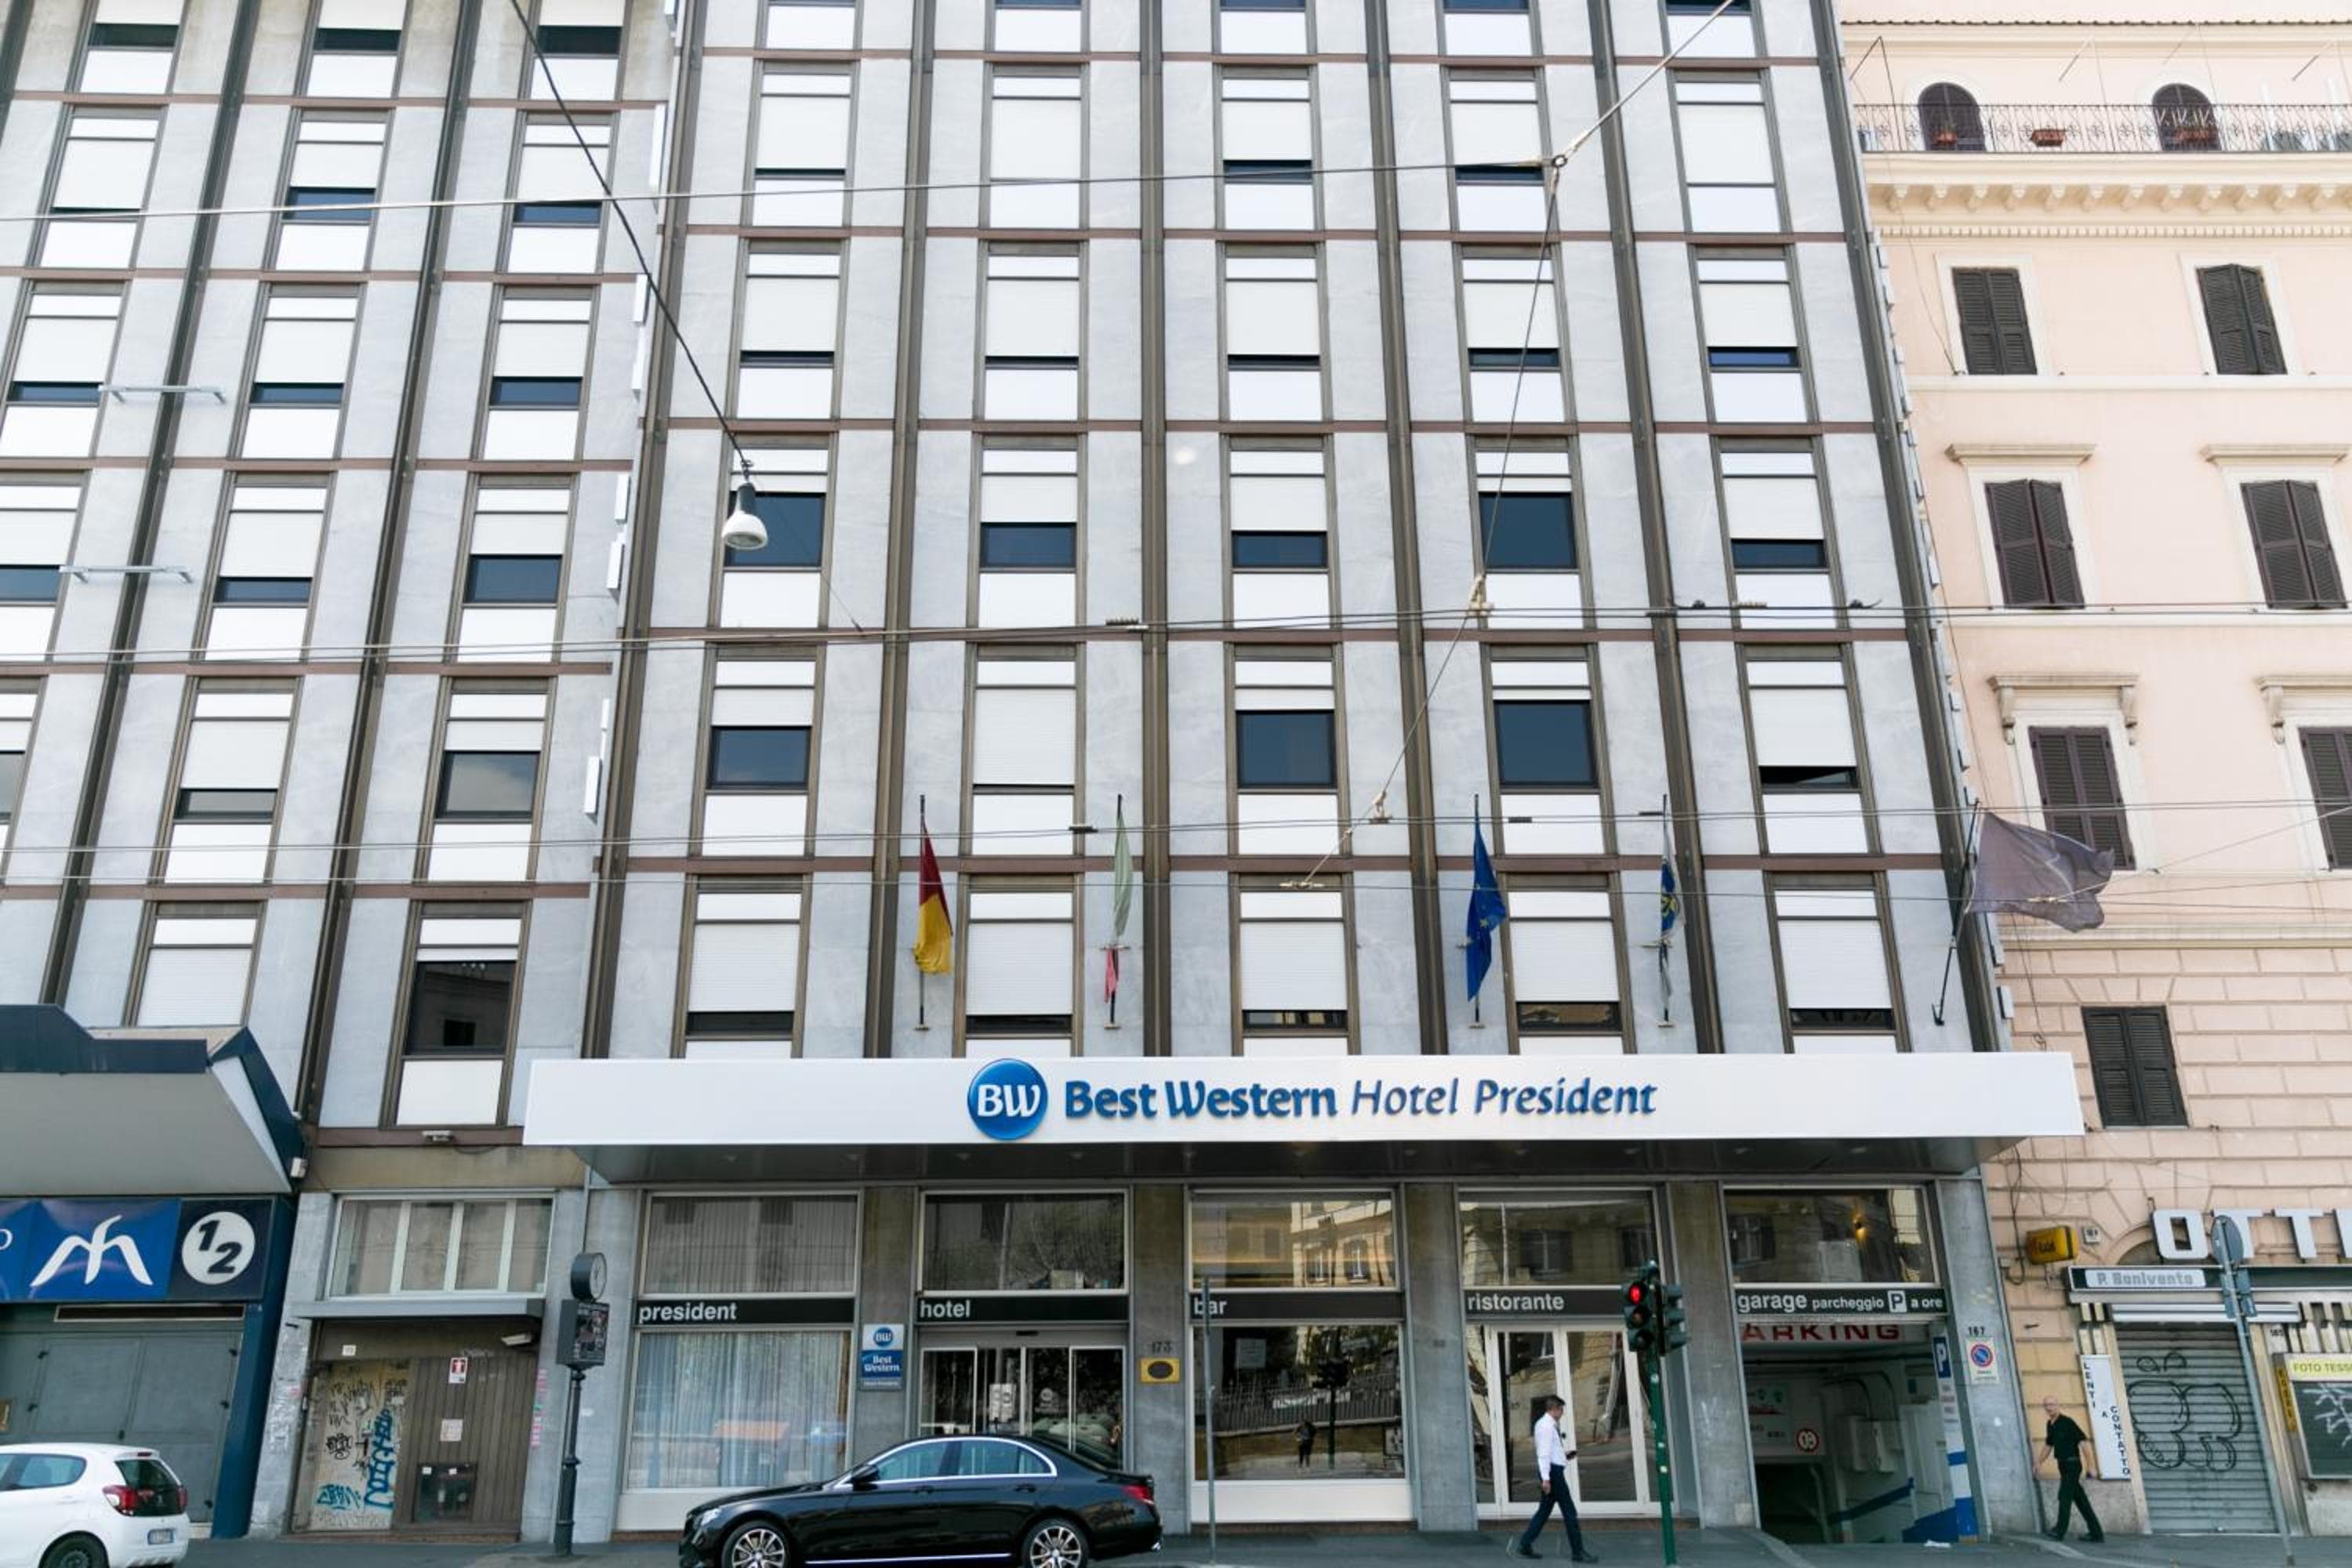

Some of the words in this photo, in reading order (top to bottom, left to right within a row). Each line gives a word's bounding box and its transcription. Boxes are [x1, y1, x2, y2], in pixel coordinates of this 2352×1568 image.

[978, 1083, 1041, 1118] BW
[1065, 1080, 1158, 1119] Best
[1165, 1080, 1338, 1119] Western
[1351, 1078, 1459, 1116] Hotel
[1474, 1076, 1657, 1116] President
[919, 1300, 971, 1319] hotel
[1193, 1296, 1227, 1316] bar
[1467, 1292, 1566, 1311] ristorante
[1737, 1294, 1807, 1313] garage
[1812, 1296, 1884, 1312] parcheggio
[1911, 1300, 1918, 1308] a
[1922, 1298, 1944, 1308] ore
[638, 1301, 739, 1324] president
[863, 1364, 900, 1373] Western
[873, 1355, 892, 1364] Best
[2292, 1363, 2321, 1374] FOTO
[2083, 1362, 2096, 1409] LENTI
[2110, 1405, 2131, 1475] CONTATTO
